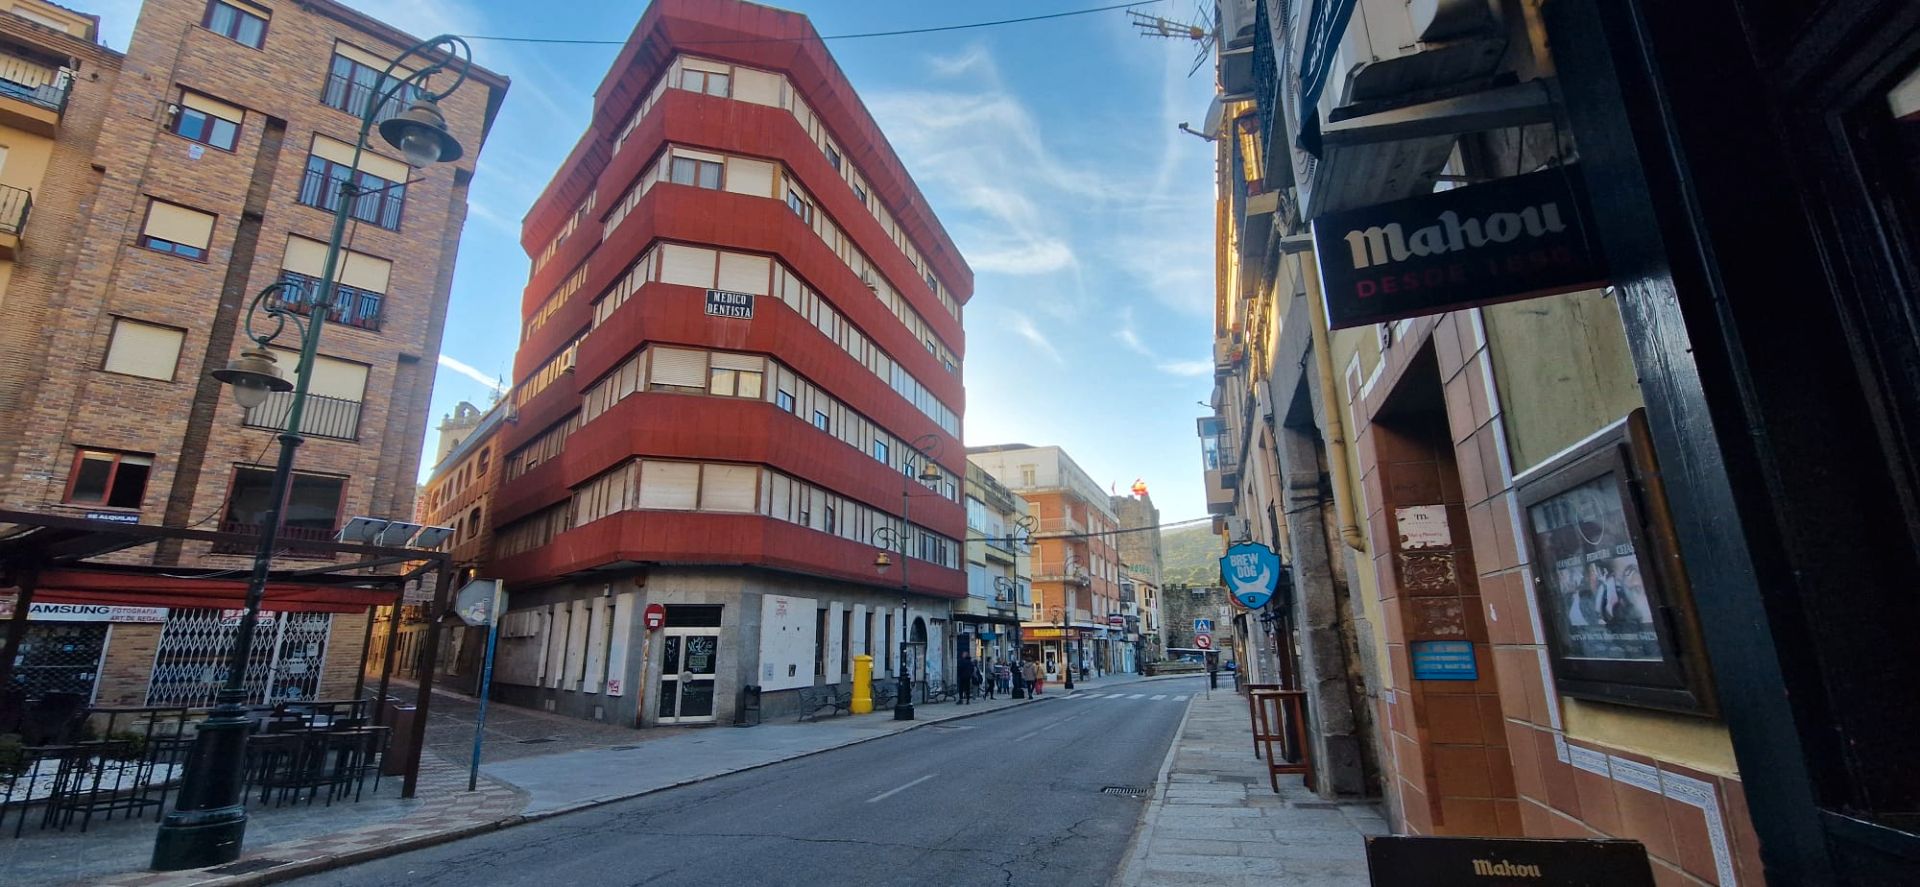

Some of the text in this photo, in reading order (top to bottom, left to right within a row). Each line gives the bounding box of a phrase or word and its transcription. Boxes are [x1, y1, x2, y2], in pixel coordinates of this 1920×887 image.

[1344, 203, 1567, 269] Mahou
[1356, 263, 1467, 298] DESDE
[713, 291, 746, 304] MEDICO
[707, 303, 750, 317] DENTISTA
[98, 514, 138, 522] ALQUILAN
[1230, 552, 1259, 567] BREW
[1237, 565, 1257, 578] DOG
[29, 604, 110, 614] AMSUNG
[1472, 859, 1541, 877] Mahou
